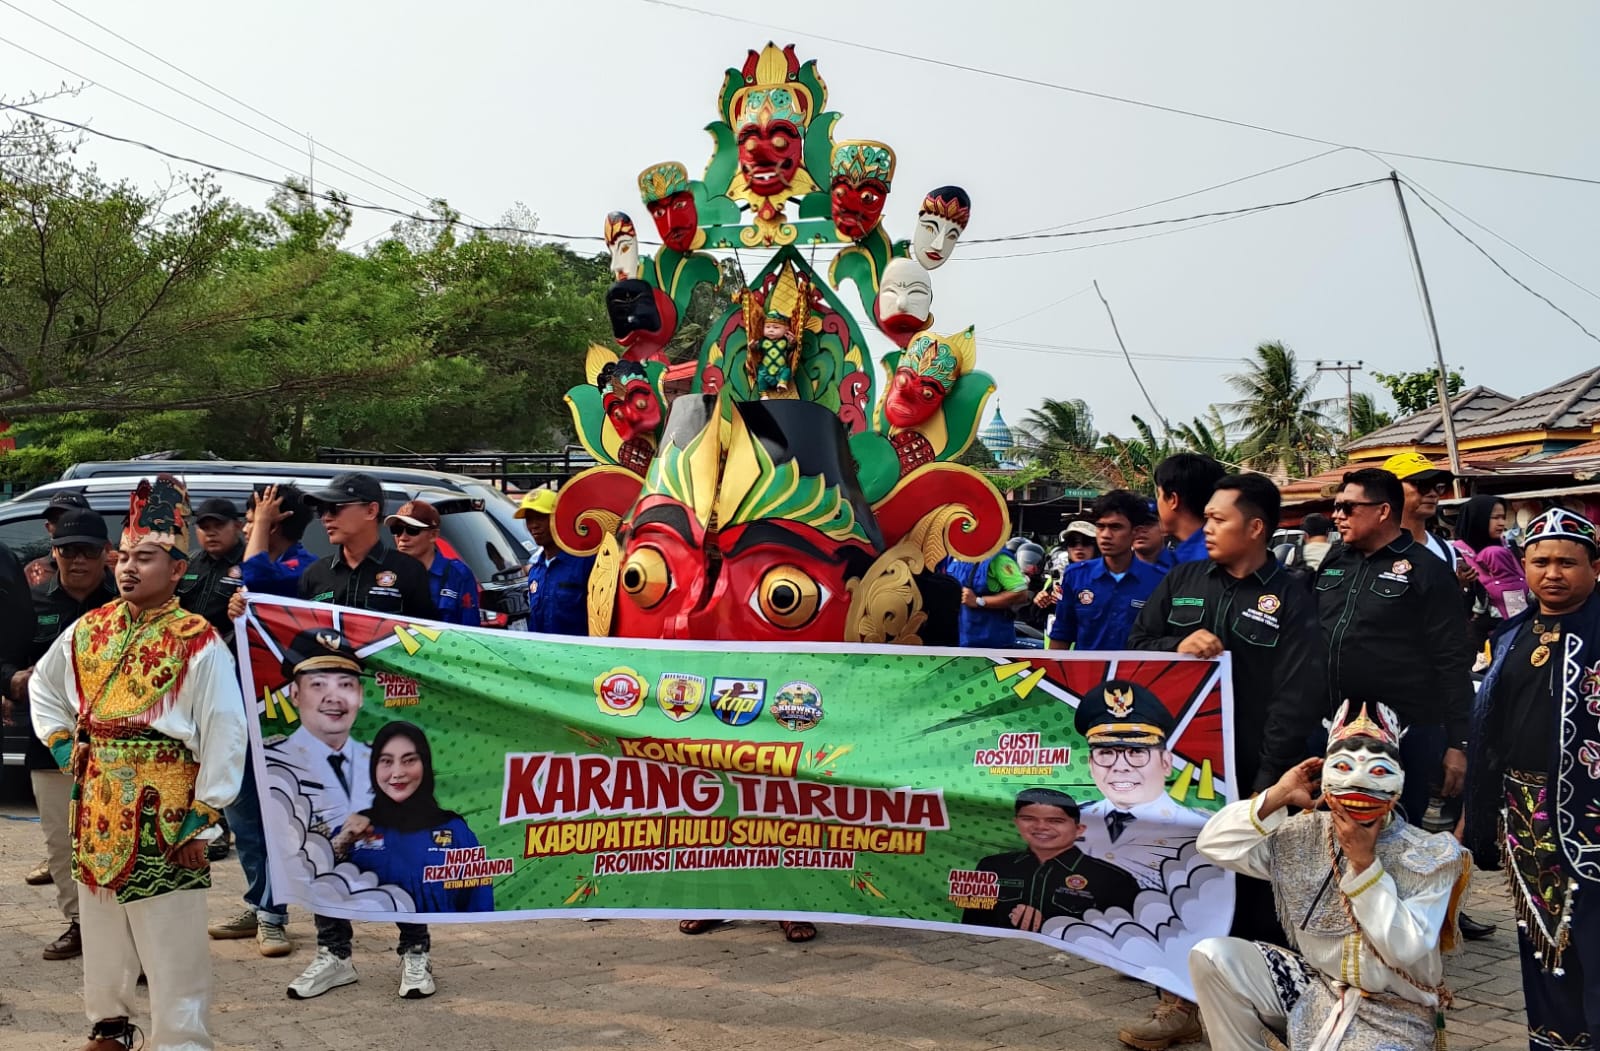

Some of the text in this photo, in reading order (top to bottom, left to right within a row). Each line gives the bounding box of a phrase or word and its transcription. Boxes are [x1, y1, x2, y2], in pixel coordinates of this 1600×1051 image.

[716, 690, 756, 725] knpi
[998, 733, 1040, 750] GUSTI
[622, 741, 799, 777] KONTINGEN
[975, 748, 1070, 765] ROSYADI ELMI
[505, 753, 946, 829] KARANG TARUNA
[526, 819, 924, 856] KABUPATEN HULU SUNGAI TENGAH
[445, 847, 486, 865] NADEA
[595, 848, 855, 874] PROVINSI KALIMANTAN SELATAN
[424, 858, 513, 881] RIZKY ANANDA
[949, 870, 997, 884] AHMAD
[950, 882, 998, 897] RIDUAN
